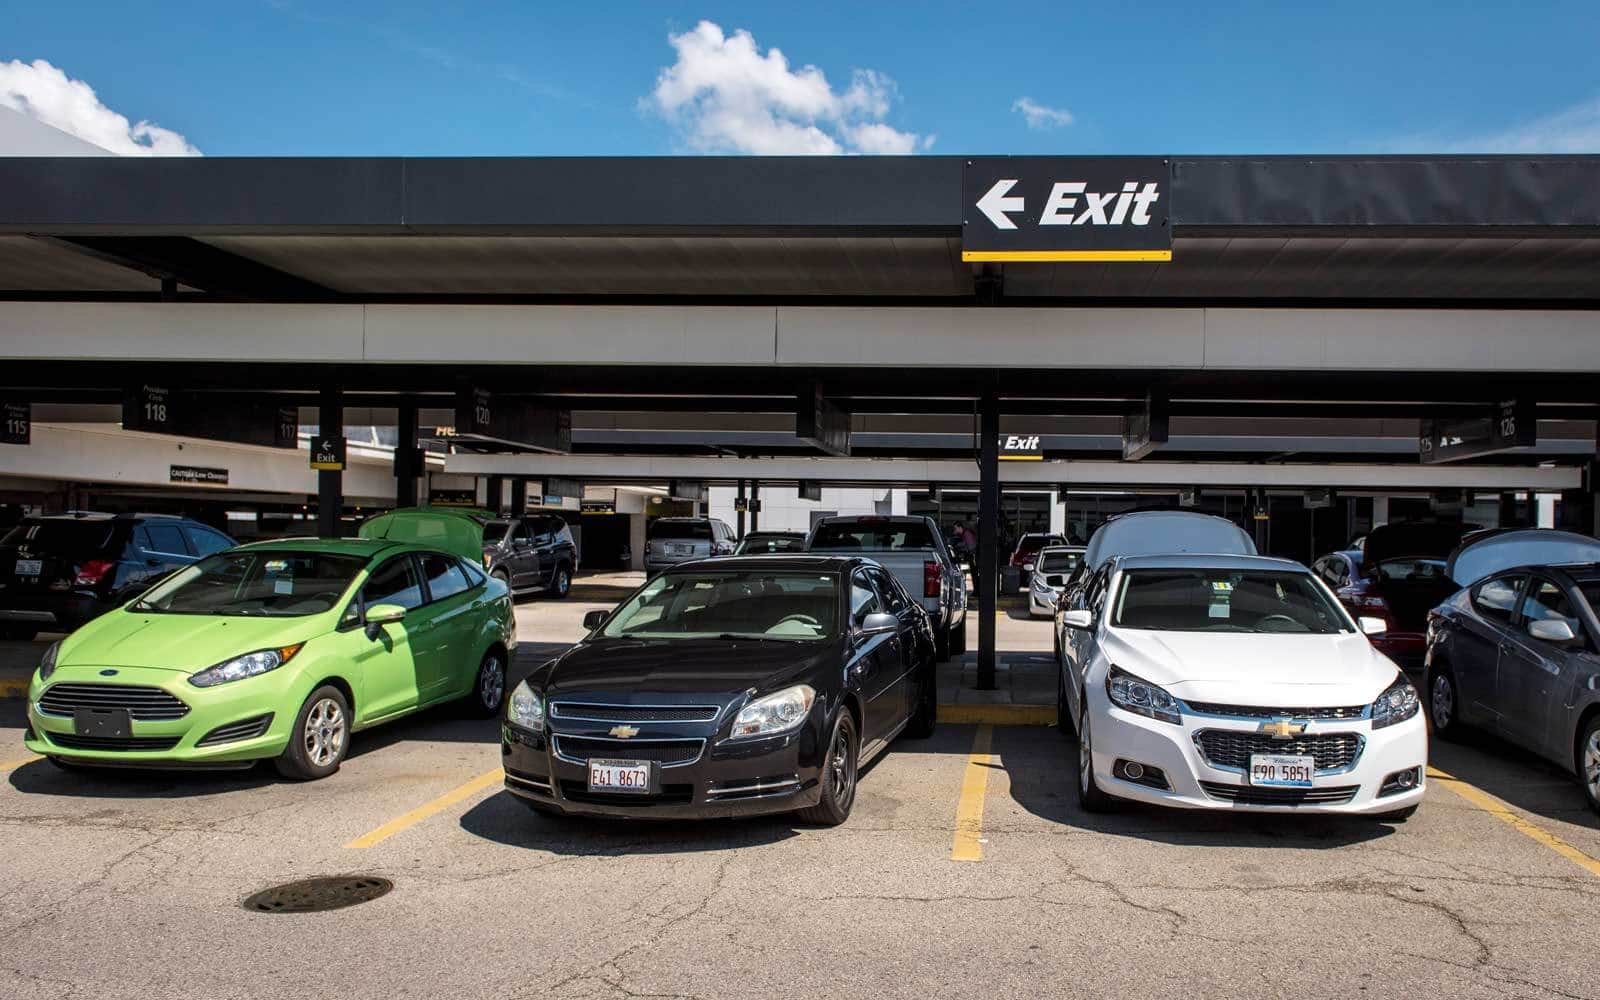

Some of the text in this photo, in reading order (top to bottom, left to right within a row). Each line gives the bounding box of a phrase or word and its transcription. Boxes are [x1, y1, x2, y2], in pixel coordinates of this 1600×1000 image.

[1038, 182, 1159, 225] Exit
[144, 402, 167, 422] 118
[475, 405, 491, 425] 120
[5, 419, 28, 435] 115
[1004, 436, 1040, 450] Exit
[316, 453, 336, 462] Exit
[592, 769, 646, 787] E41 8673
[1282, 765, 1311, 782] 5851
